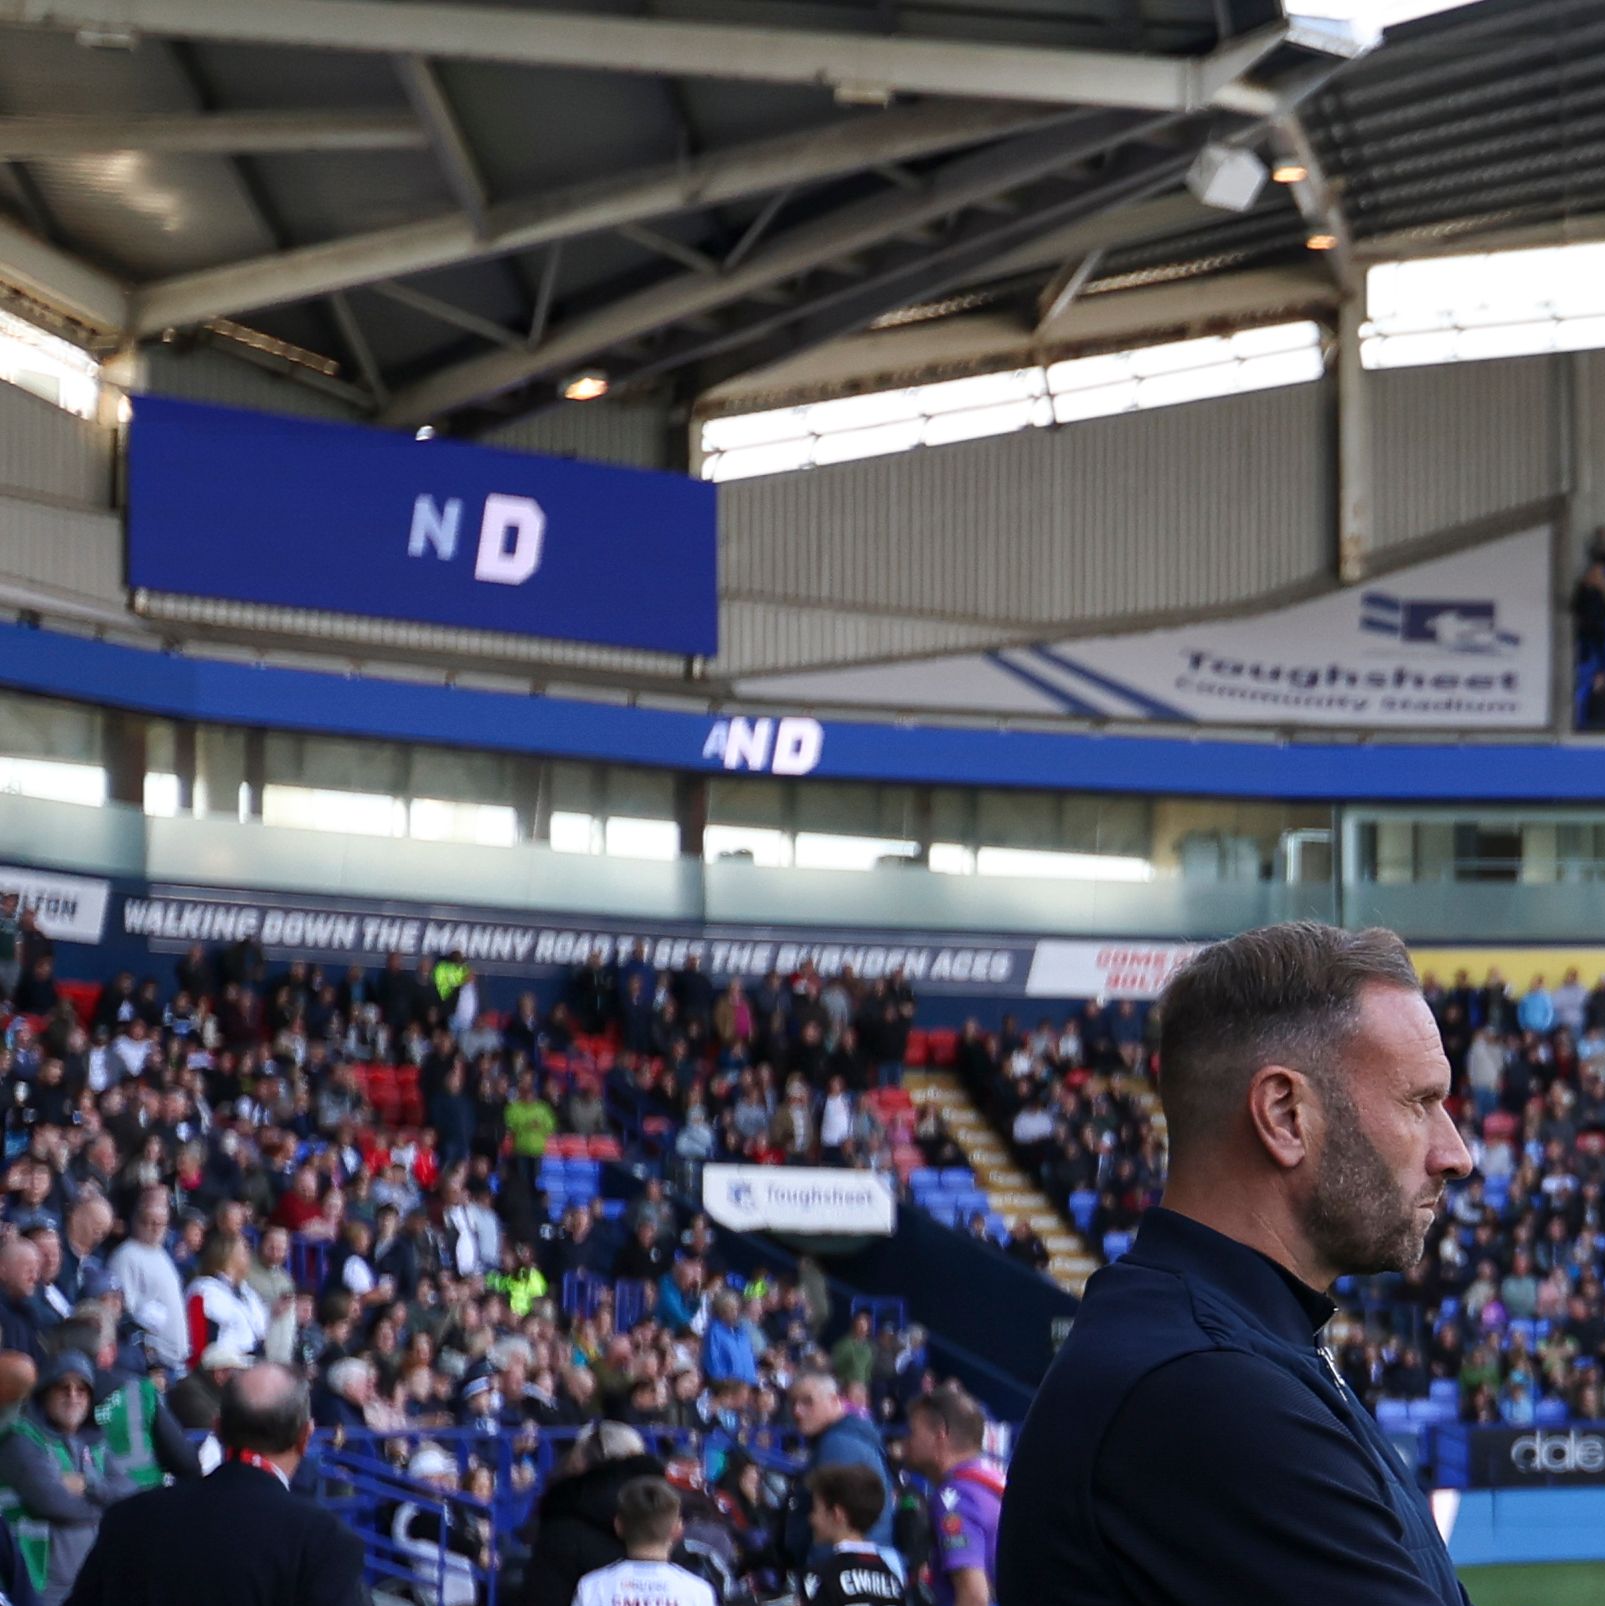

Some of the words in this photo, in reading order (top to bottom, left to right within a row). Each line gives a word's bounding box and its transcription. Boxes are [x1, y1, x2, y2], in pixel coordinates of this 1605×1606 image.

[1185, 650, 1519, 691] Toughsheet
[1175, 675, 1368, 713] Community
[1380, 697, 1518, 714] Stadium
[124, 898, 260, 942] WALKING
[261, 909, 358, 951] DOWN
[362, 916, 421, 956] THE
[421, 920, 535, 963] MANNY
[710, 939, 774, 974] THE
